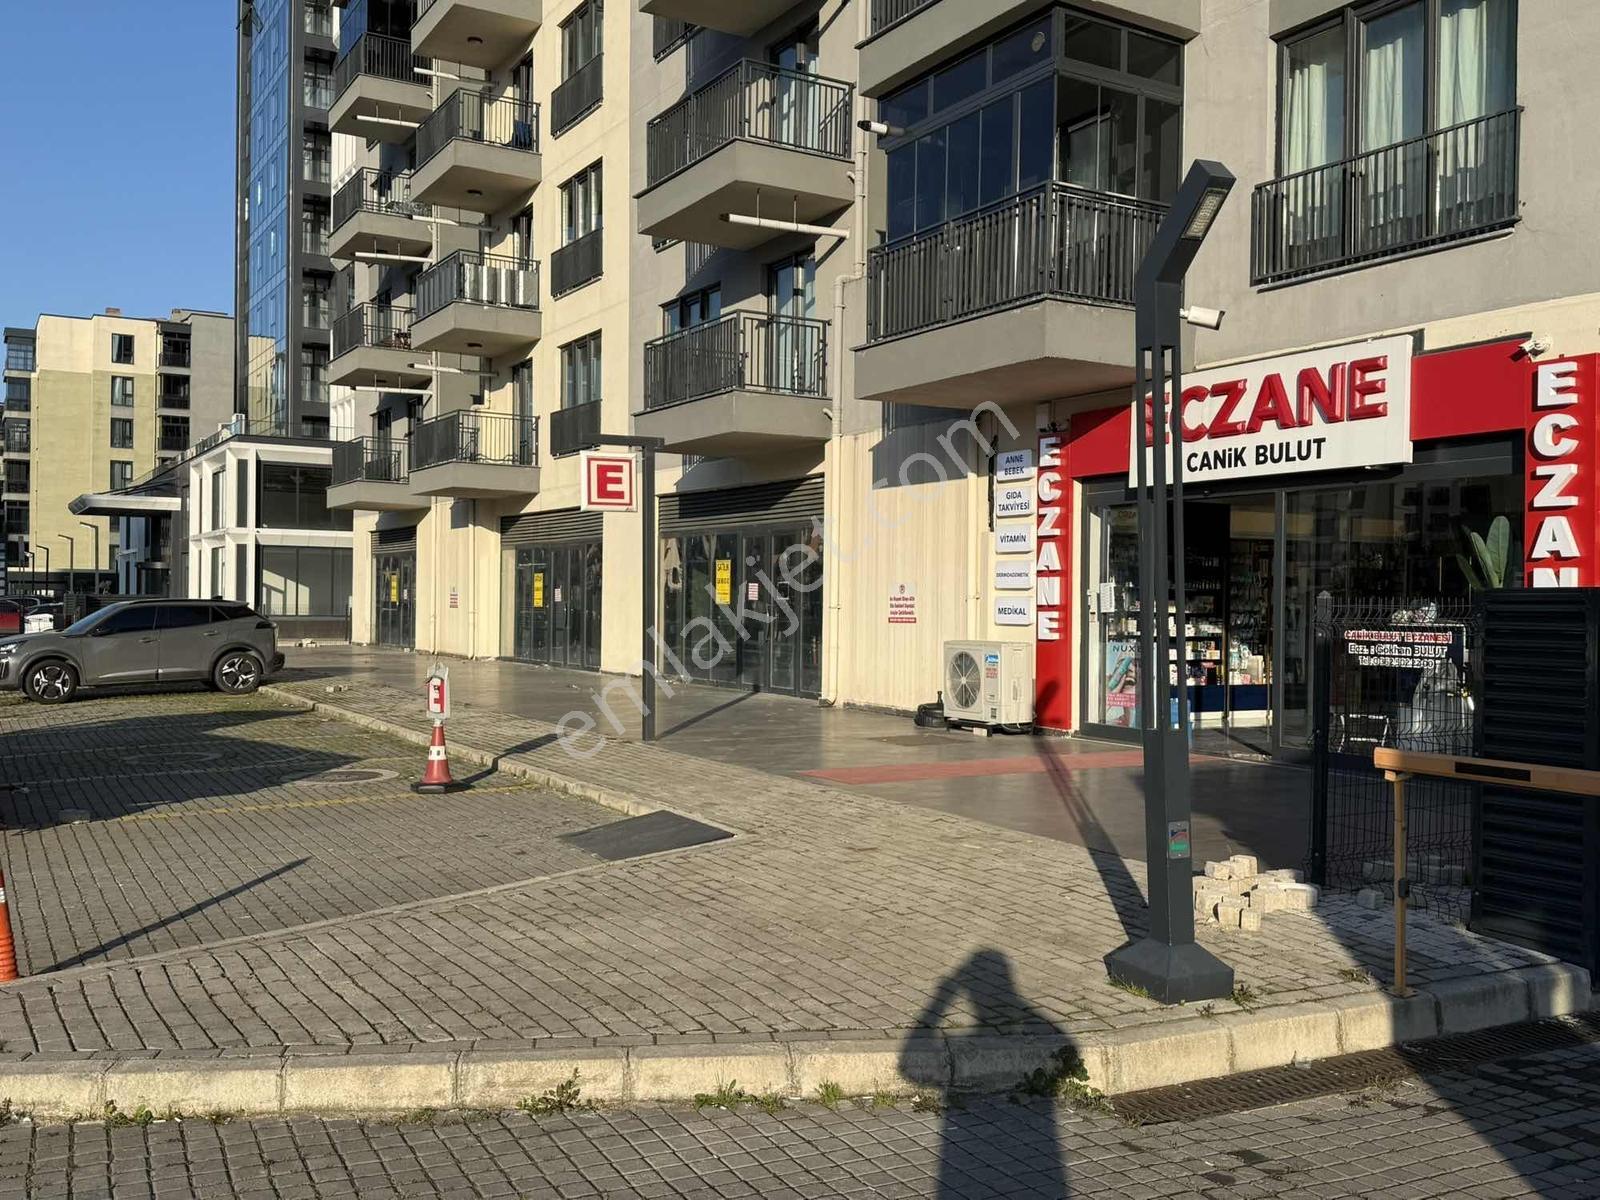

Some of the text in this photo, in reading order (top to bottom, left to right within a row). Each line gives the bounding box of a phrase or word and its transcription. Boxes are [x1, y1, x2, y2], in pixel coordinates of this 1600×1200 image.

[1145, 355, 1388, 448] ECZANE
[1005, 454, 1024, 464] ANNE
[1255, 437, 1326, 466] BULUT
[1004, 466, 1025, 476] BEBEK
[597, 464, 625, 499] E
[1006, 491, 1022, 500] GIDA
[1037, 437, 1062, 640] ECZANE
[998, 605, 1027, 615] MEDİKAL
